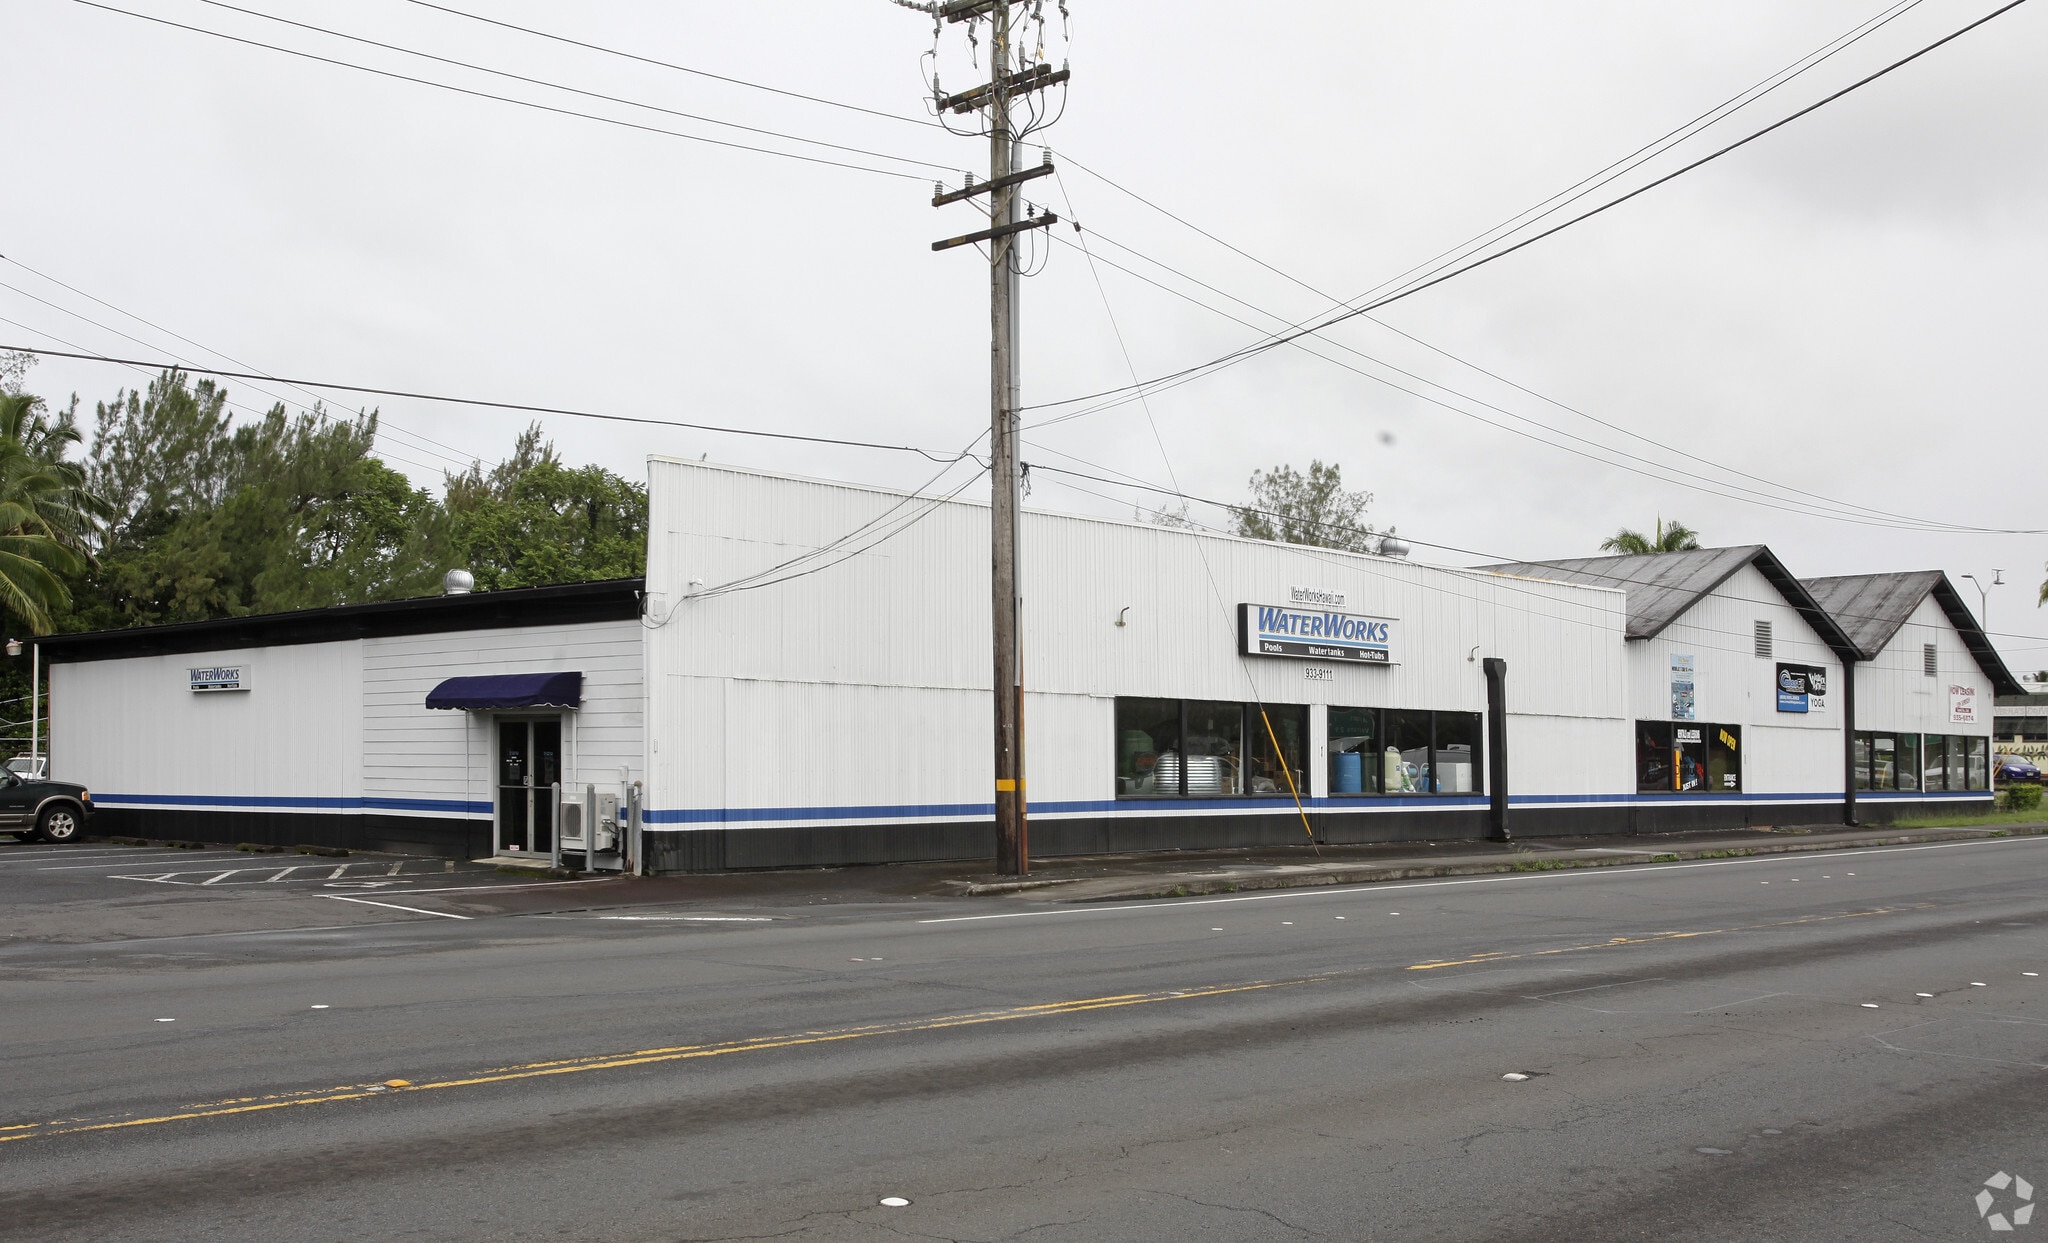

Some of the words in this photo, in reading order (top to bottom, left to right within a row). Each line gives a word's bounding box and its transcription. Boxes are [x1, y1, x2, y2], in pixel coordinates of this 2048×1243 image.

[1264, 642, 1283, 652] Pools
[1359, 650, 1385, 660] Hot-Tubs
[1305, 668, 1333, 679] 933-9111
[1810, 698, 1826, 708] YOGA
[1719, 728, 1728, 745] NOW
[1727, 735, 1737, 751] OPEN
[1682, 781, 1691, 792] JUST
